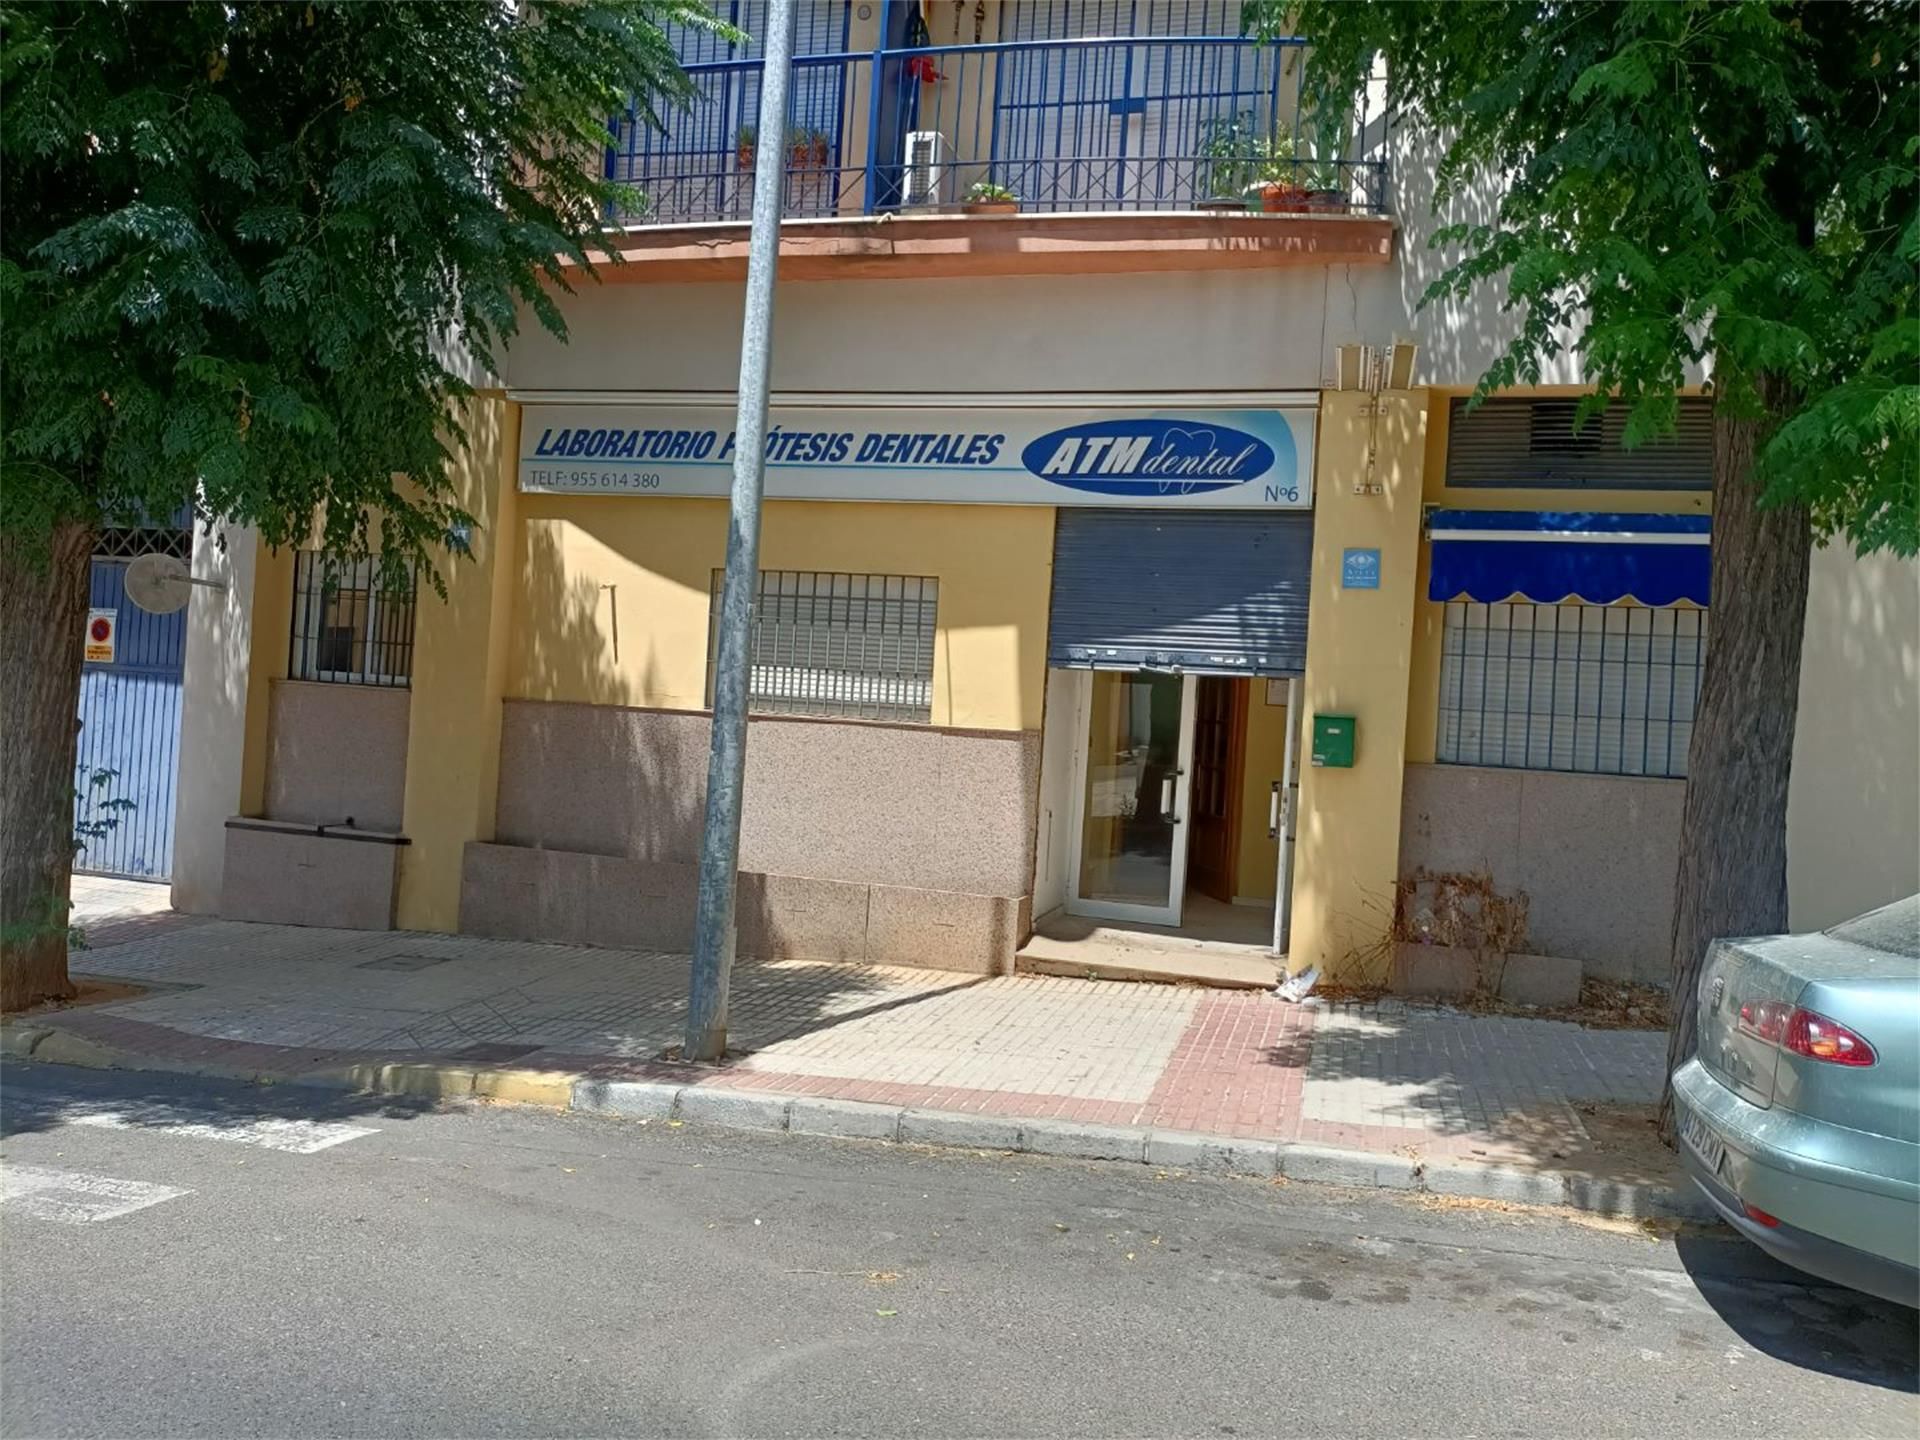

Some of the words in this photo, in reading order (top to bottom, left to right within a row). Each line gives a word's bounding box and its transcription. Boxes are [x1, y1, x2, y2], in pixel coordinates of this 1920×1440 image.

[535, 429, 717, 459] LABORATORIO
[718, 425, 853, 462] PÓTESIS
[855, 433, 1005, 464] DENTALES
[1041, 436, 1152, 474] ATM
[1142, 443, 1257, 475] dental
[530, 470, 567, 486] TELF:
[571, 472, 596, 486] 955
[601, 473, 628, 487] 614
[634, 473, 660, 488] 380
